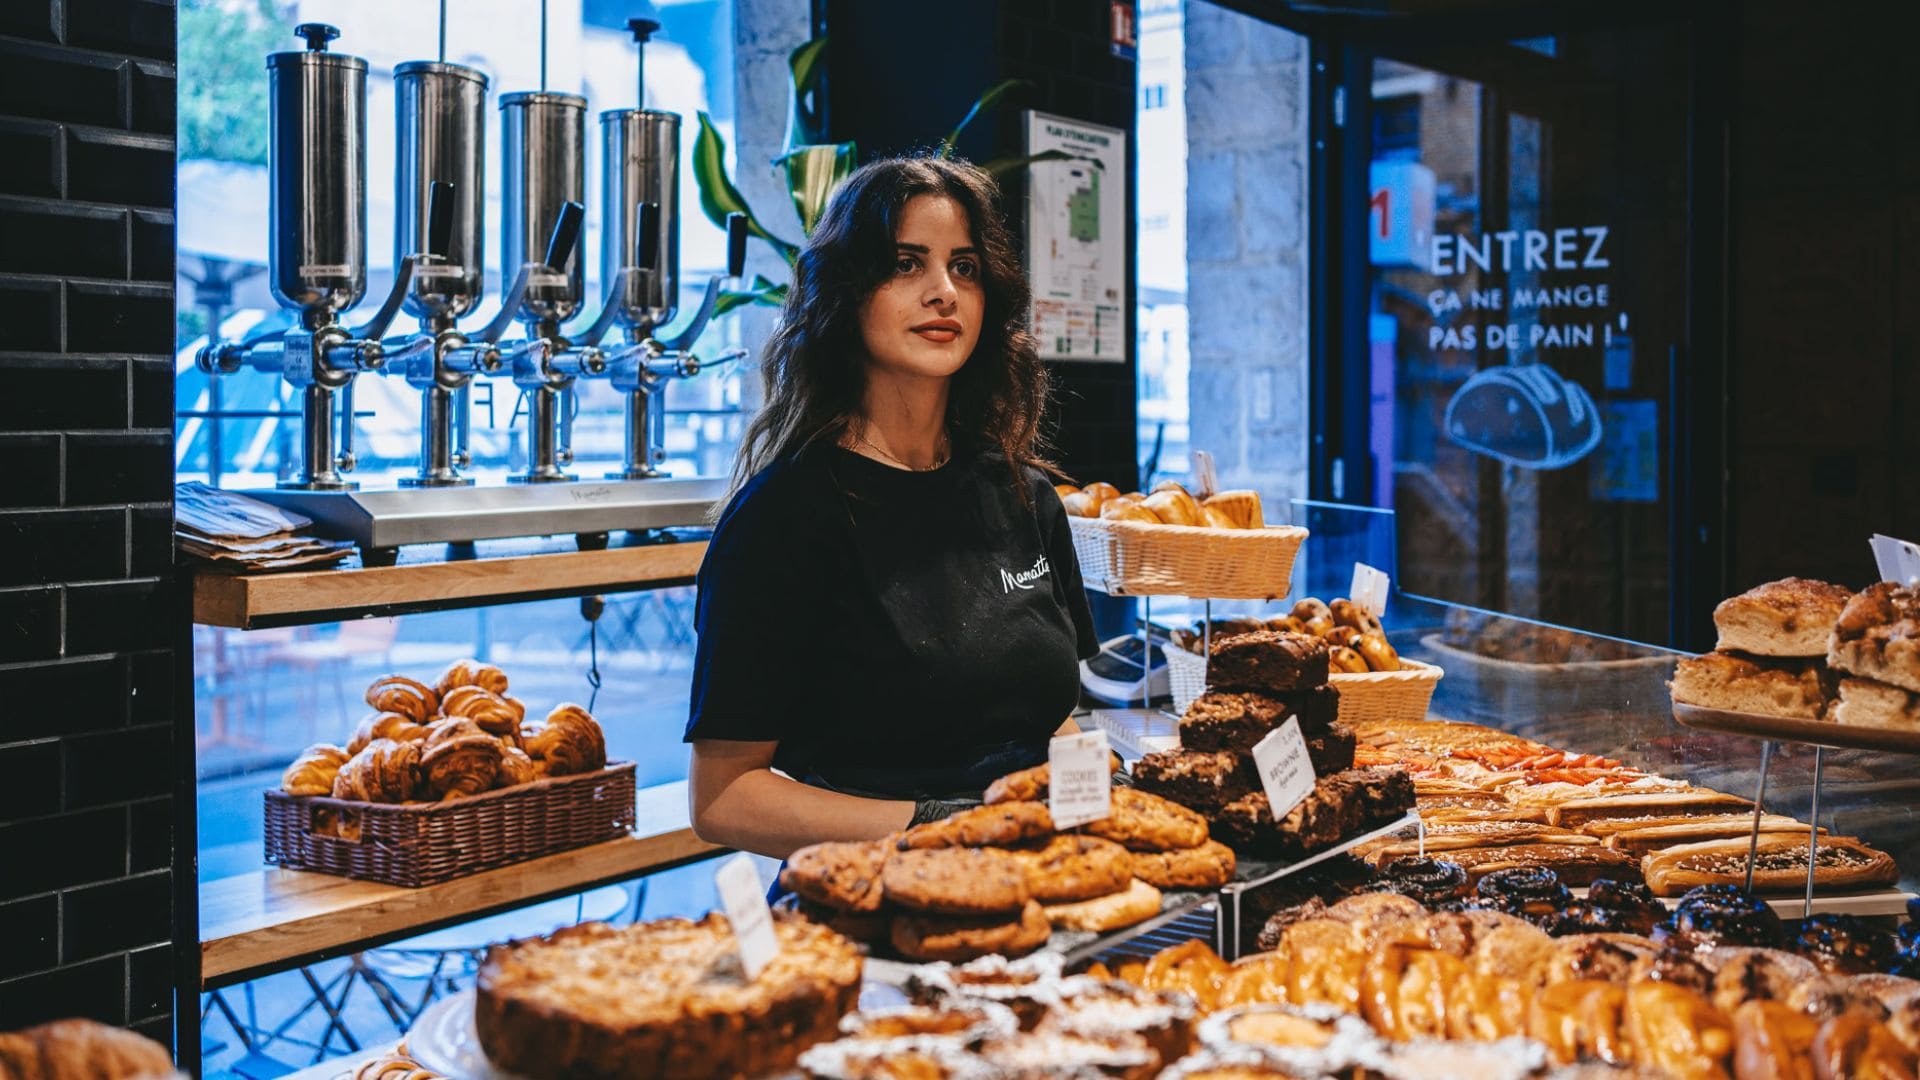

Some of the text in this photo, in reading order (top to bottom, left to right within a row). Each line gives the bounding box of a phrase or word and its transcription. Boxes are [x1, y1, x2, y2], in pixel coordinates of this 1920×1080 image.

[1428, 284, 1609, 317] ÇA NE MANGE
[1429, 324, 1477, 350] PAS
[1486, 324, 1520, 350] DE
[1529, 323, 1593, 348] PAIN
